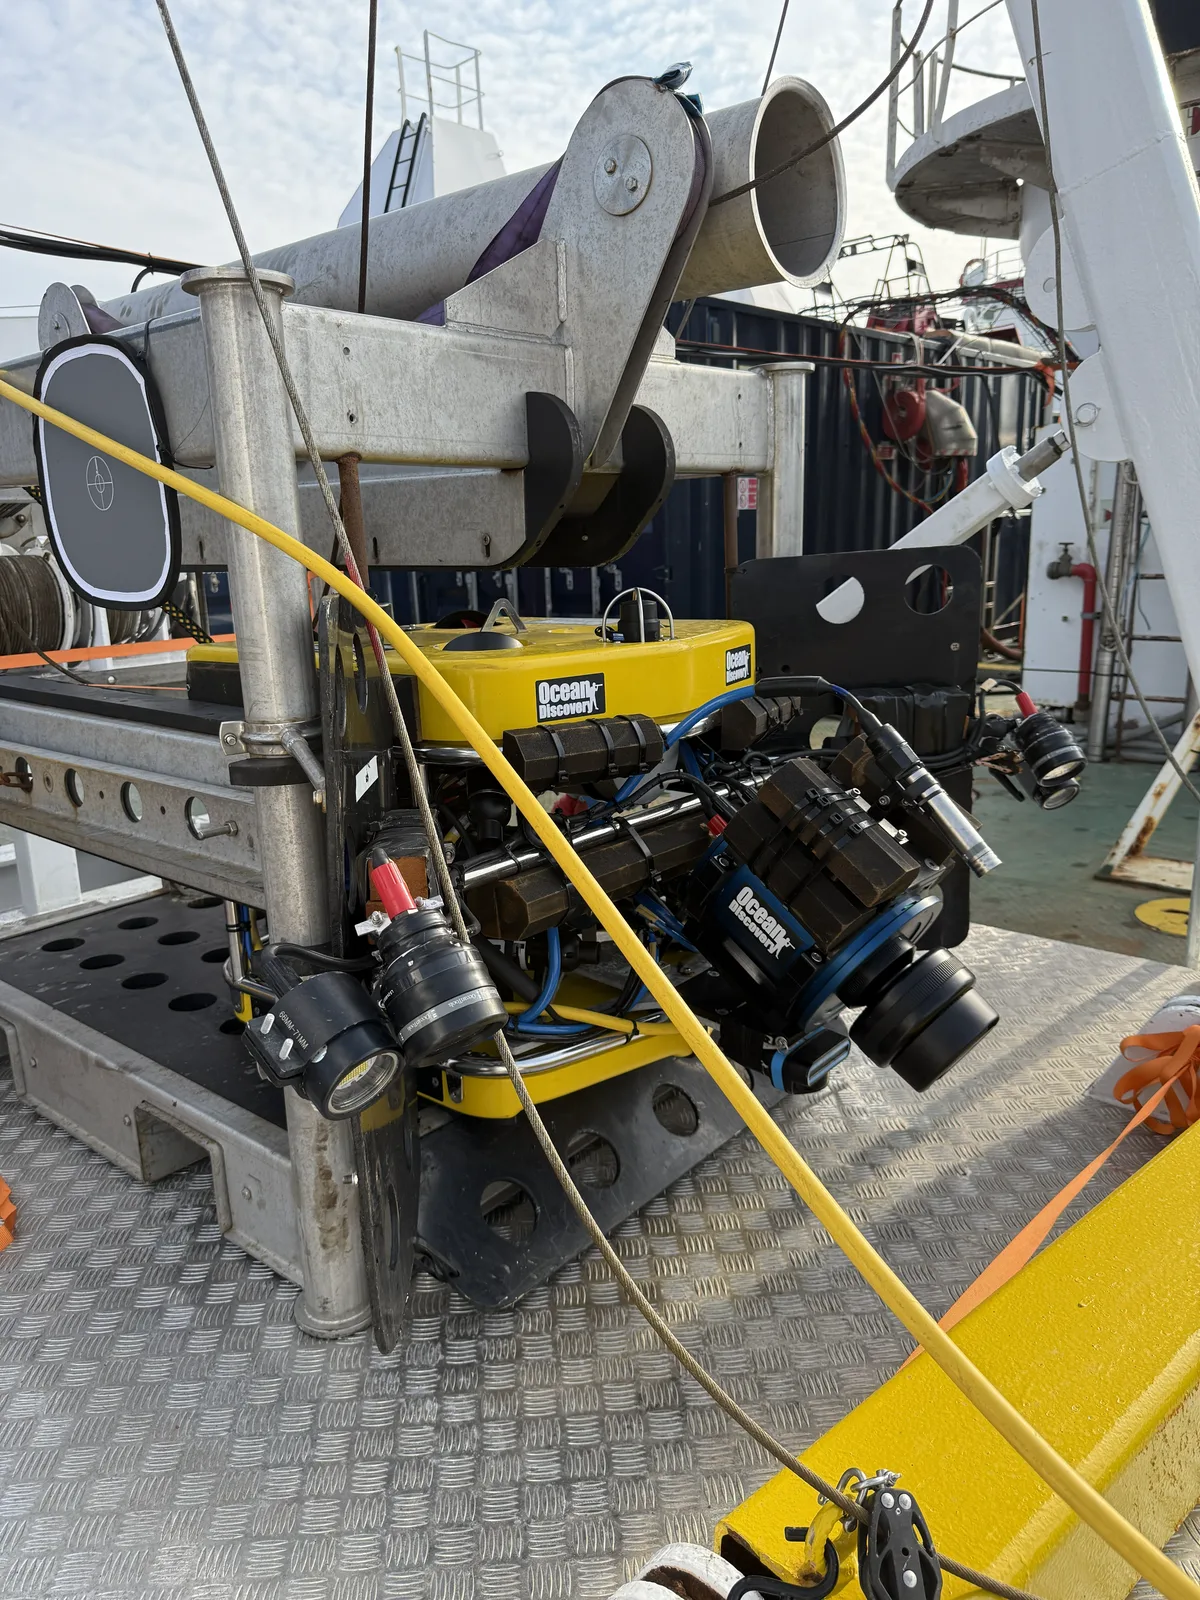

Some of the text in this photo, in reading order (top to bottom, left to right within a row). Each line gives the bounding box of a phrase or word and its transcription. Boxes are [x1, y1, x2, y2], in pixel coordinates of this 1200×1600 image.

[726, 650, 747, 671] Ocean
[538, 680, 592, 704] Ocean
[538, 700, 593, 719] Discovery
[736, 886, 787, 942] Ocean
[728, 899, 780, 955] Discovery
